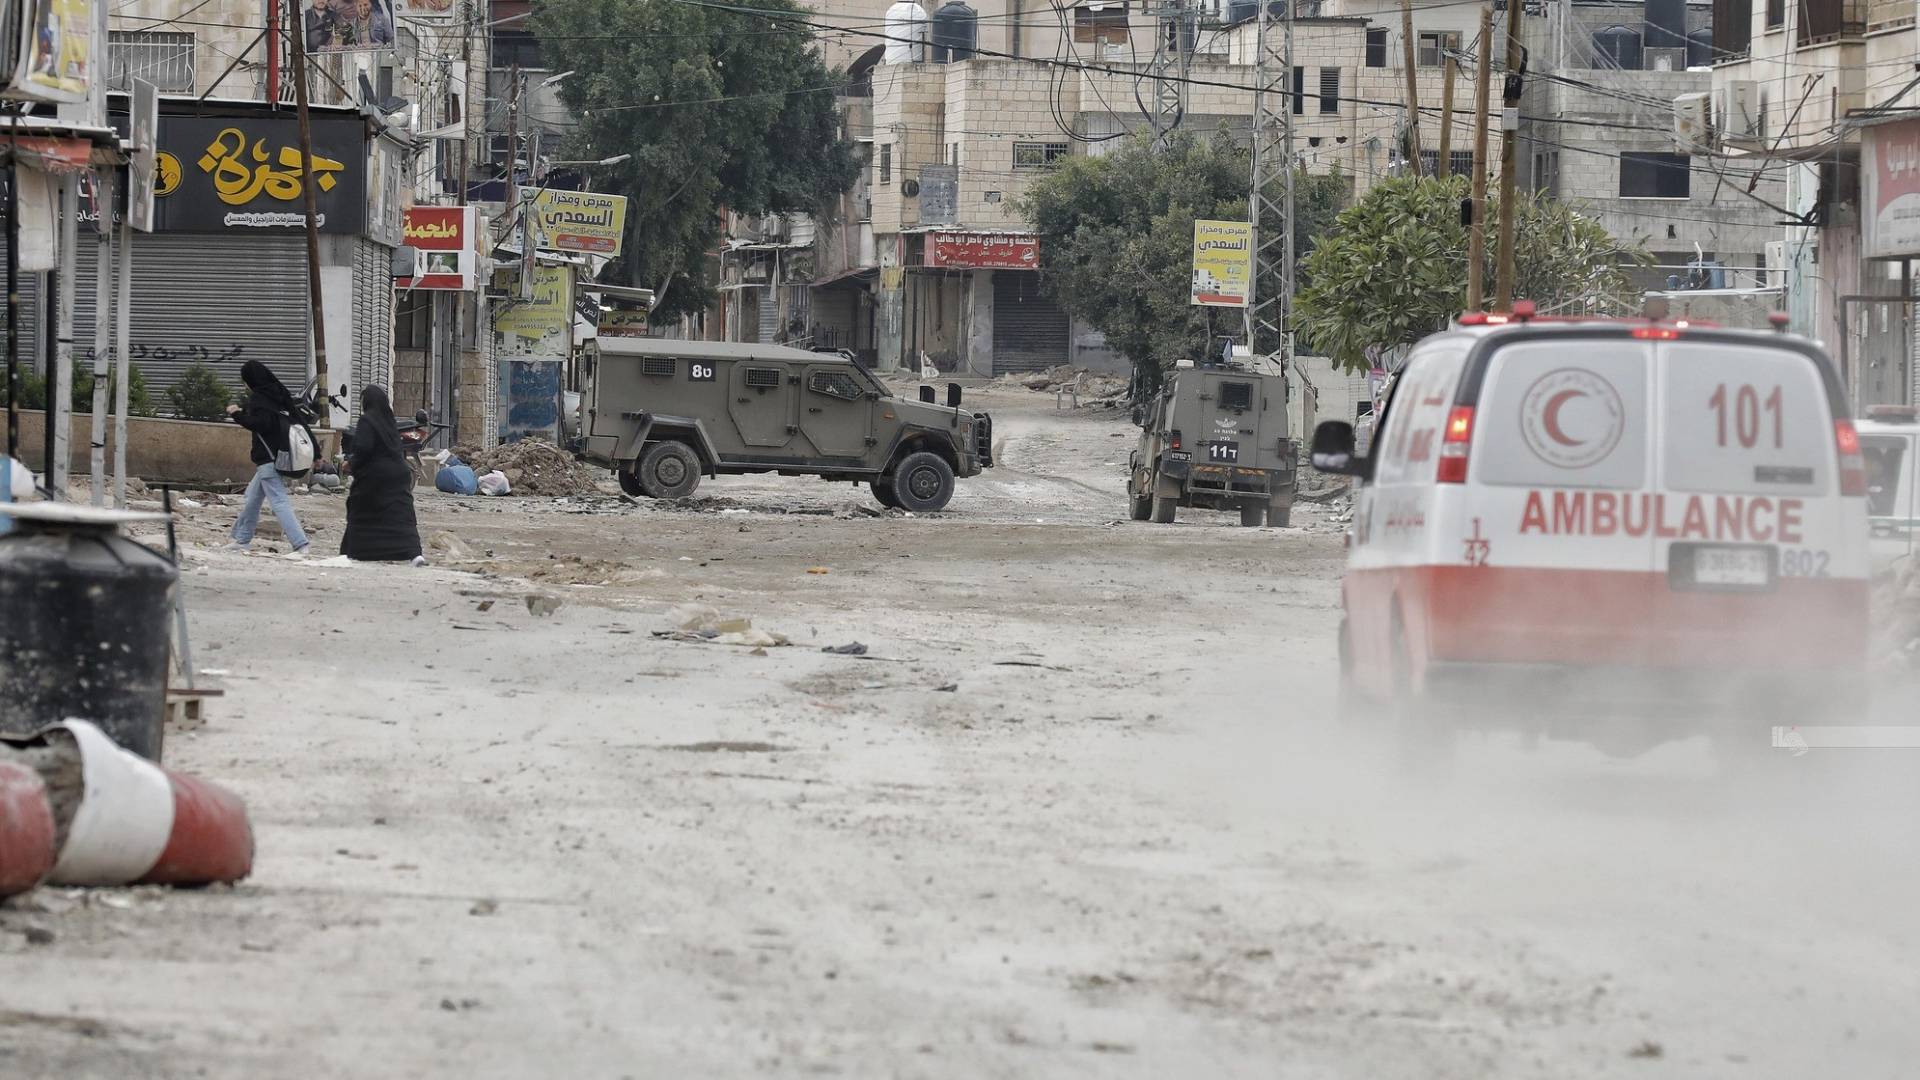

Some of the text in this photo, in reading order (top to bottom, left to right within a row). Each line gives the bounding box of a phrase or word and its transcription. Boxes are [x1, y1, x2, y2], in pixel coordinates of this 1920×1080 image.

[403, 214, 458, 239] ملحمة
[545, 209, 614, 229] السعدي
[1199, 238, 1247, 254] السعدي
[1709, 383, 1785, 449] 101
[1519, 490, 1805, 543] AMBULANCE
[1782, 550, 1831, 577] 802
